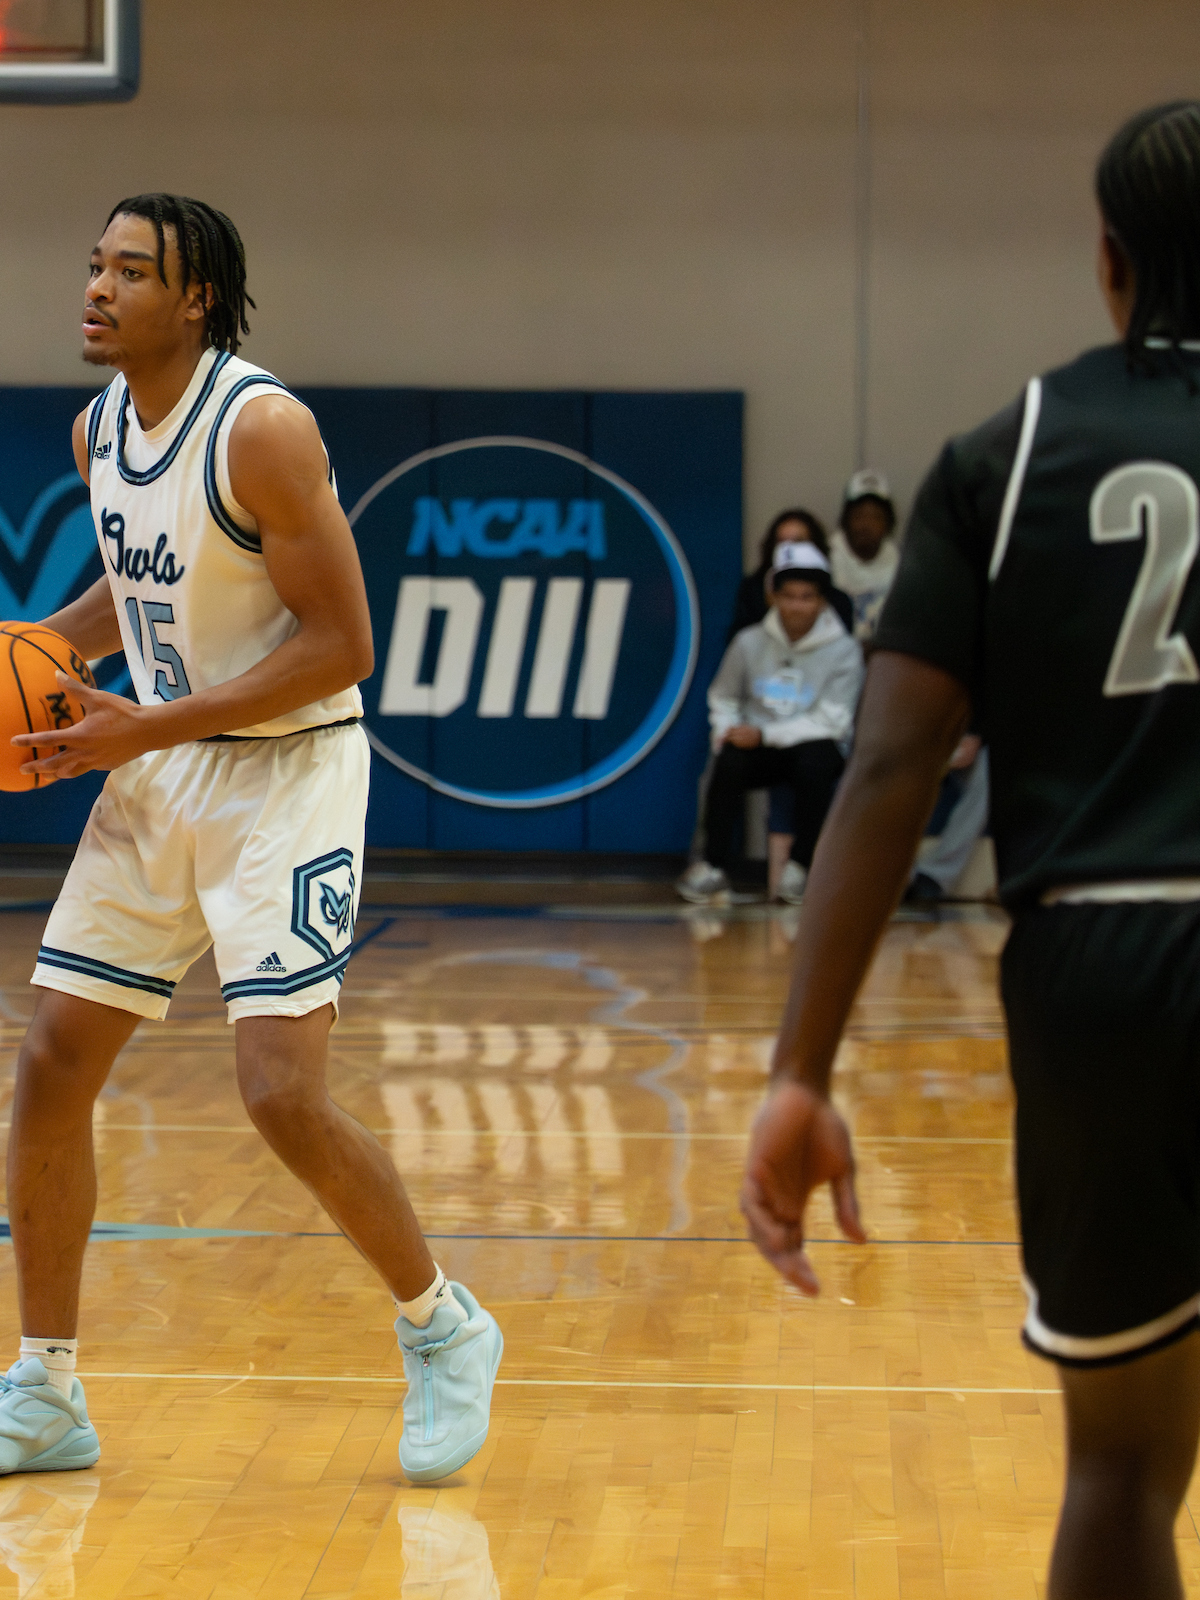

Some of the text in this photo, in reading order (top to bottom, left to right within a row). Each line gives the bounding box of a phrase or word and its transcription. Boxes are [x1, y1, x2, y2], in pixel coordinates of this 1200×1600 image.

[101, 507, 185, 585] Owls
[406, 495, 607, 560] NCAA
[378, 575, 632, 719] DIII
[256, 963, 287, 972] adidas
